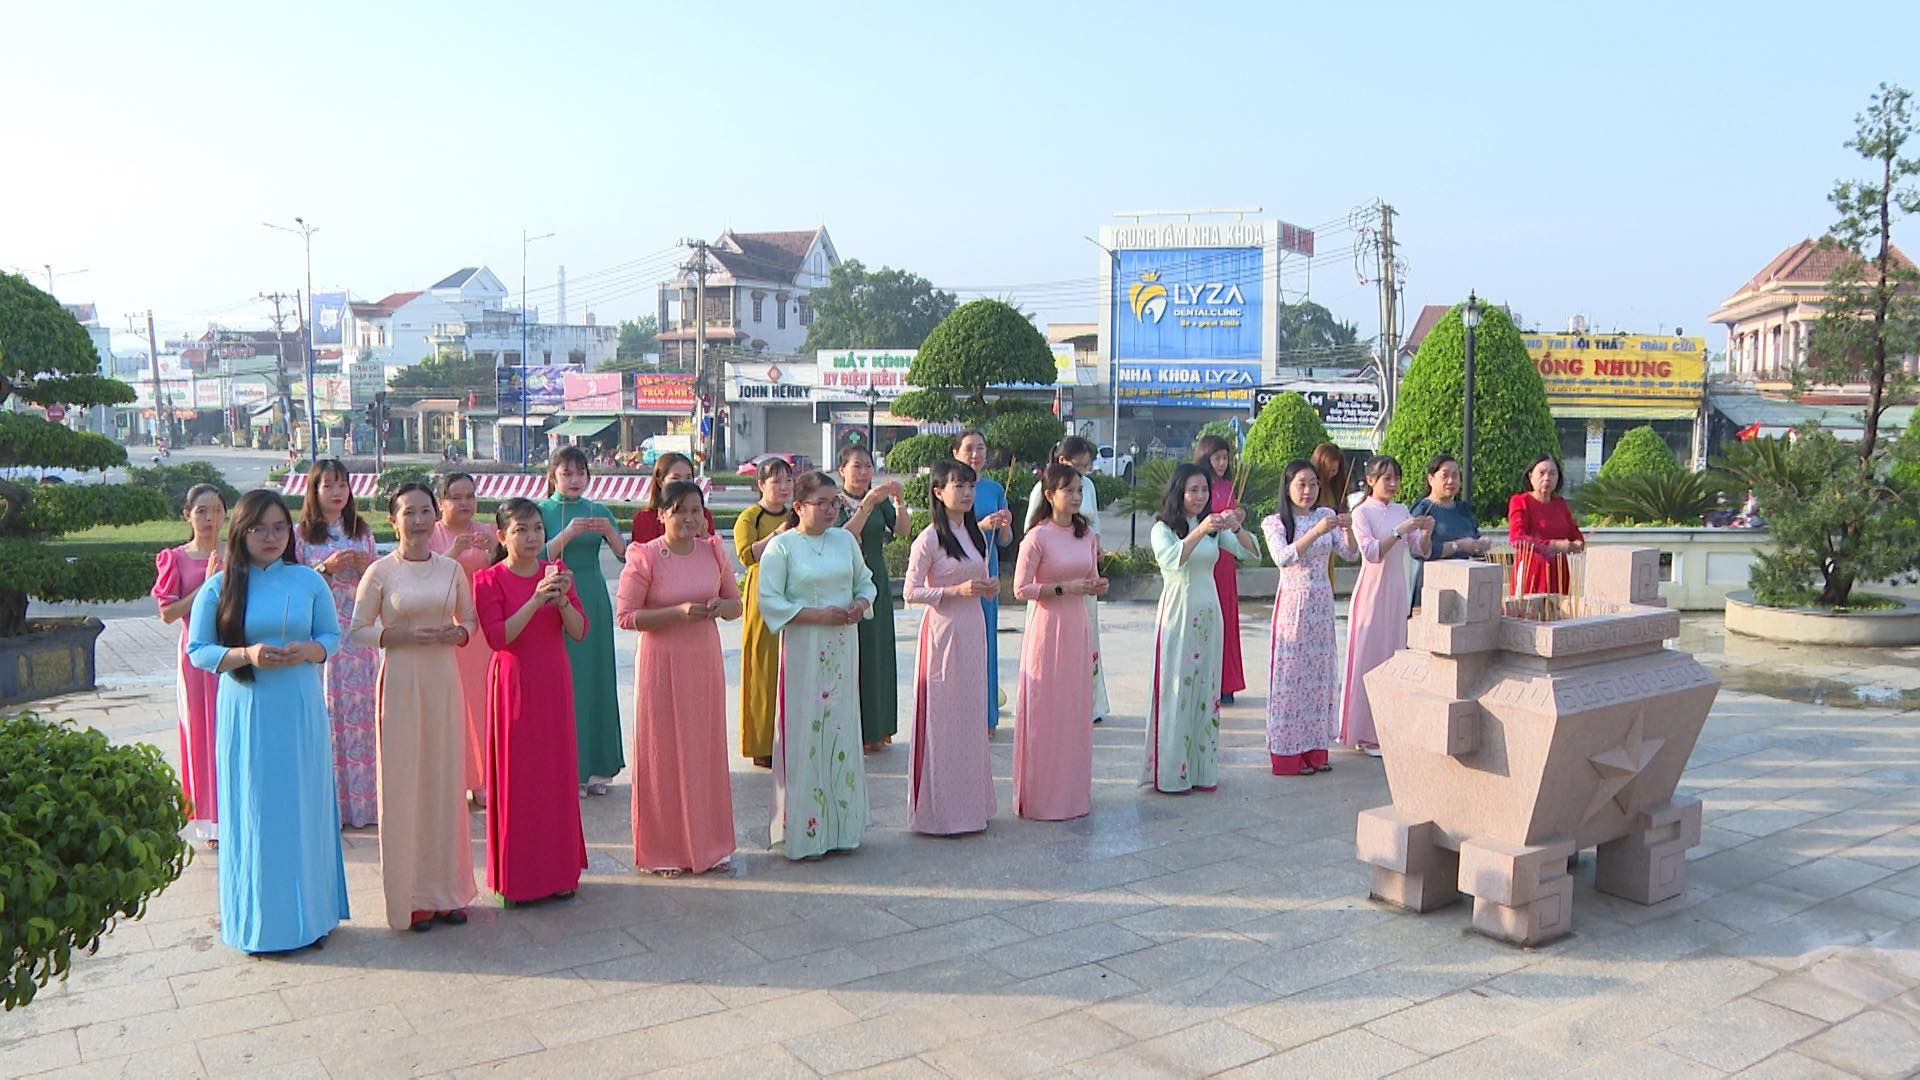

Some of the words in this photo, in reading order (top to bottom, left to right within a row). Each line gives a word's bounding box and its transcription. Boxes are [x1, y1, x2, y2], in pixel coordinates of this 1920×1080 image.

[1112, 225, 1158, 248] TRUNG
[1159, 223, 1188, 247] TÂM
[1193, 225, 1221, 246] NHA
[1227, 223, 1264, 245] KHOA
[1174, 283, 1245, 304] LYZA
[1119, 368, 1152, 382] NHA
[1158, 368, 1201, 383] KHOA
[1205, 369, 1255, 384] LYZA
[1594, 359, 1672, 378] NHUNG
[738, 385, 768, 398] JOHN
[772, 385, 811, 398] HENRY
